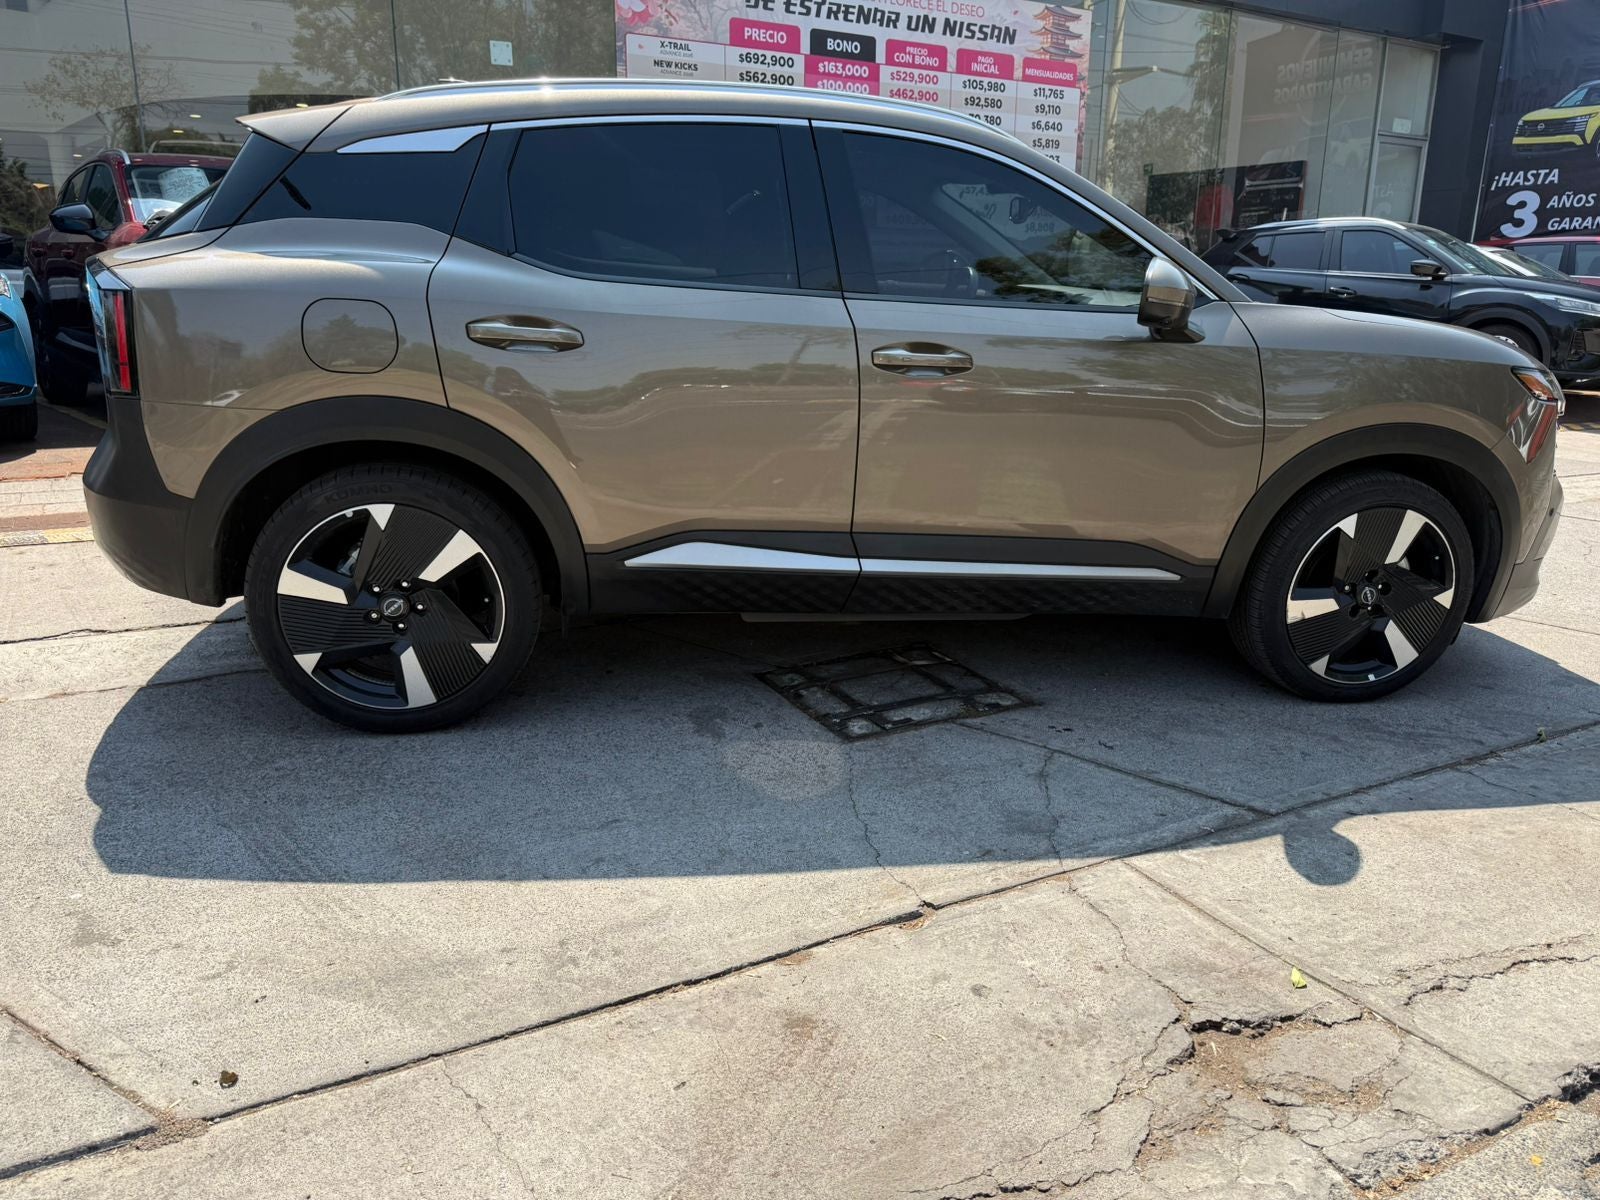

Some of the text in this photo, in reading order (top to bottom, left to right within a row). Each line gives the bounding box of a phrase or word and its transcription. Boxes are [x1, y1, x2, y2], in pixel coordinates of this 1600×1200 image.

[884, 0, 985, 18] ORECE EL DESEO
[783, 0, 901, 29] ESTRENAR
[906, 14, 937, 34] UN
[942, 17, 1017, 45] NISSAN
[744, 27, 787, 44] PRECIO
[660, 40, 692, 51] X-TRAIL
[827, 38, 861, 53] BONO
[906, 46, 928, 56] PRECIO
[653, 59, 699, 71] NEW KICKS
[738, 52, 795, 68] $692,900
[894, 52, 939, 67] CON BONO
[977, 55, 994, 64] PAGO
[818, 61, 869, 77] $163,000
[971, 62, 1000, 74] INICIAL
[1025, 67, 1074, 81] MENSUALIDADES
[739, 71, 795, 86] $562,900
[890, 71, 939, 85] $529,900
[962, 79, 1006, 93] $105,980
[889, 88, 939, 102] $462,900
[1033, 87, 1065, 100] $11,765
[964, 96, 1003, 109] $92,580
[1035, 103, 1062, 116] $9,110
[1031, 120, 1063, 132] $6,640
[1032, 137, 1060, 150] $5,819
[1490, 168, 1560, 191] ¡HASTA
[1546, 191, 1597, 208] AÑOS
[1500, 190, 1541, 238] 3
